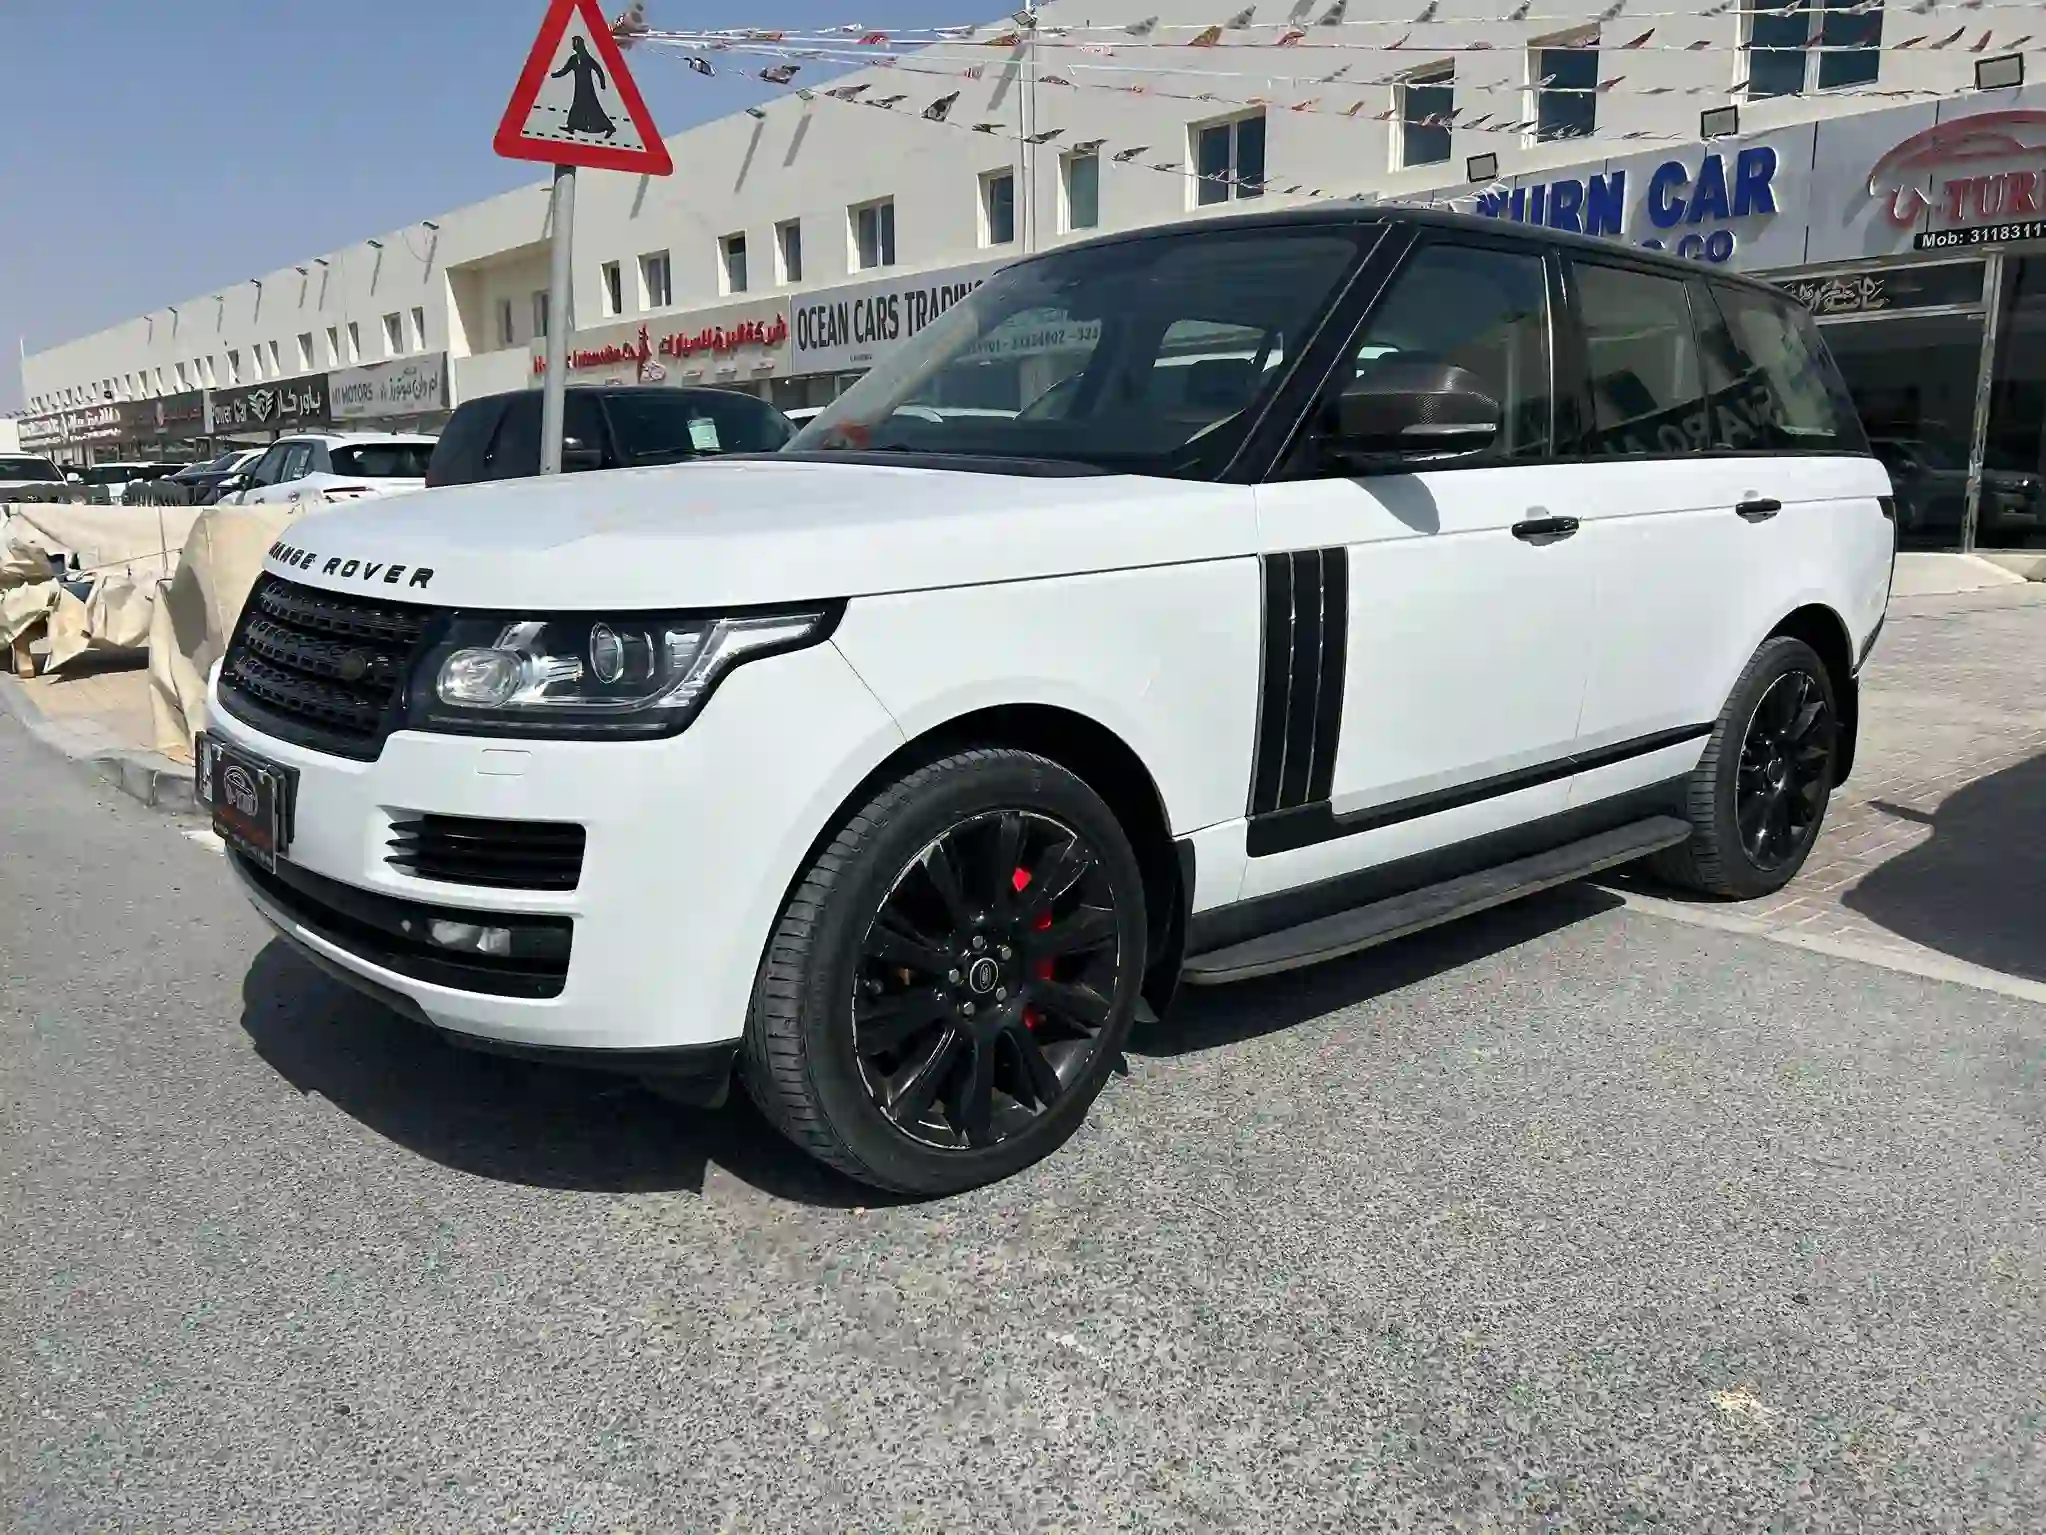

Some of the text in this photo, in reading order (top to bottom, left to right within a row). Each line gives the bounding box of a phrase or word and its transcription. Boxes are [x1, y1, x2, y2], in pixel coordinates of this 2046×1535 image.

[1649, 146, 1780, 228] CAR
[1887, 170, 2046, 229] U-TUR
[1921, 223, 2046, 249] Mob: 3118311
[798, 279, 984, 351] OCEAN CARS TRAD
[268, 540, 434, 589] RANGE ROVER
